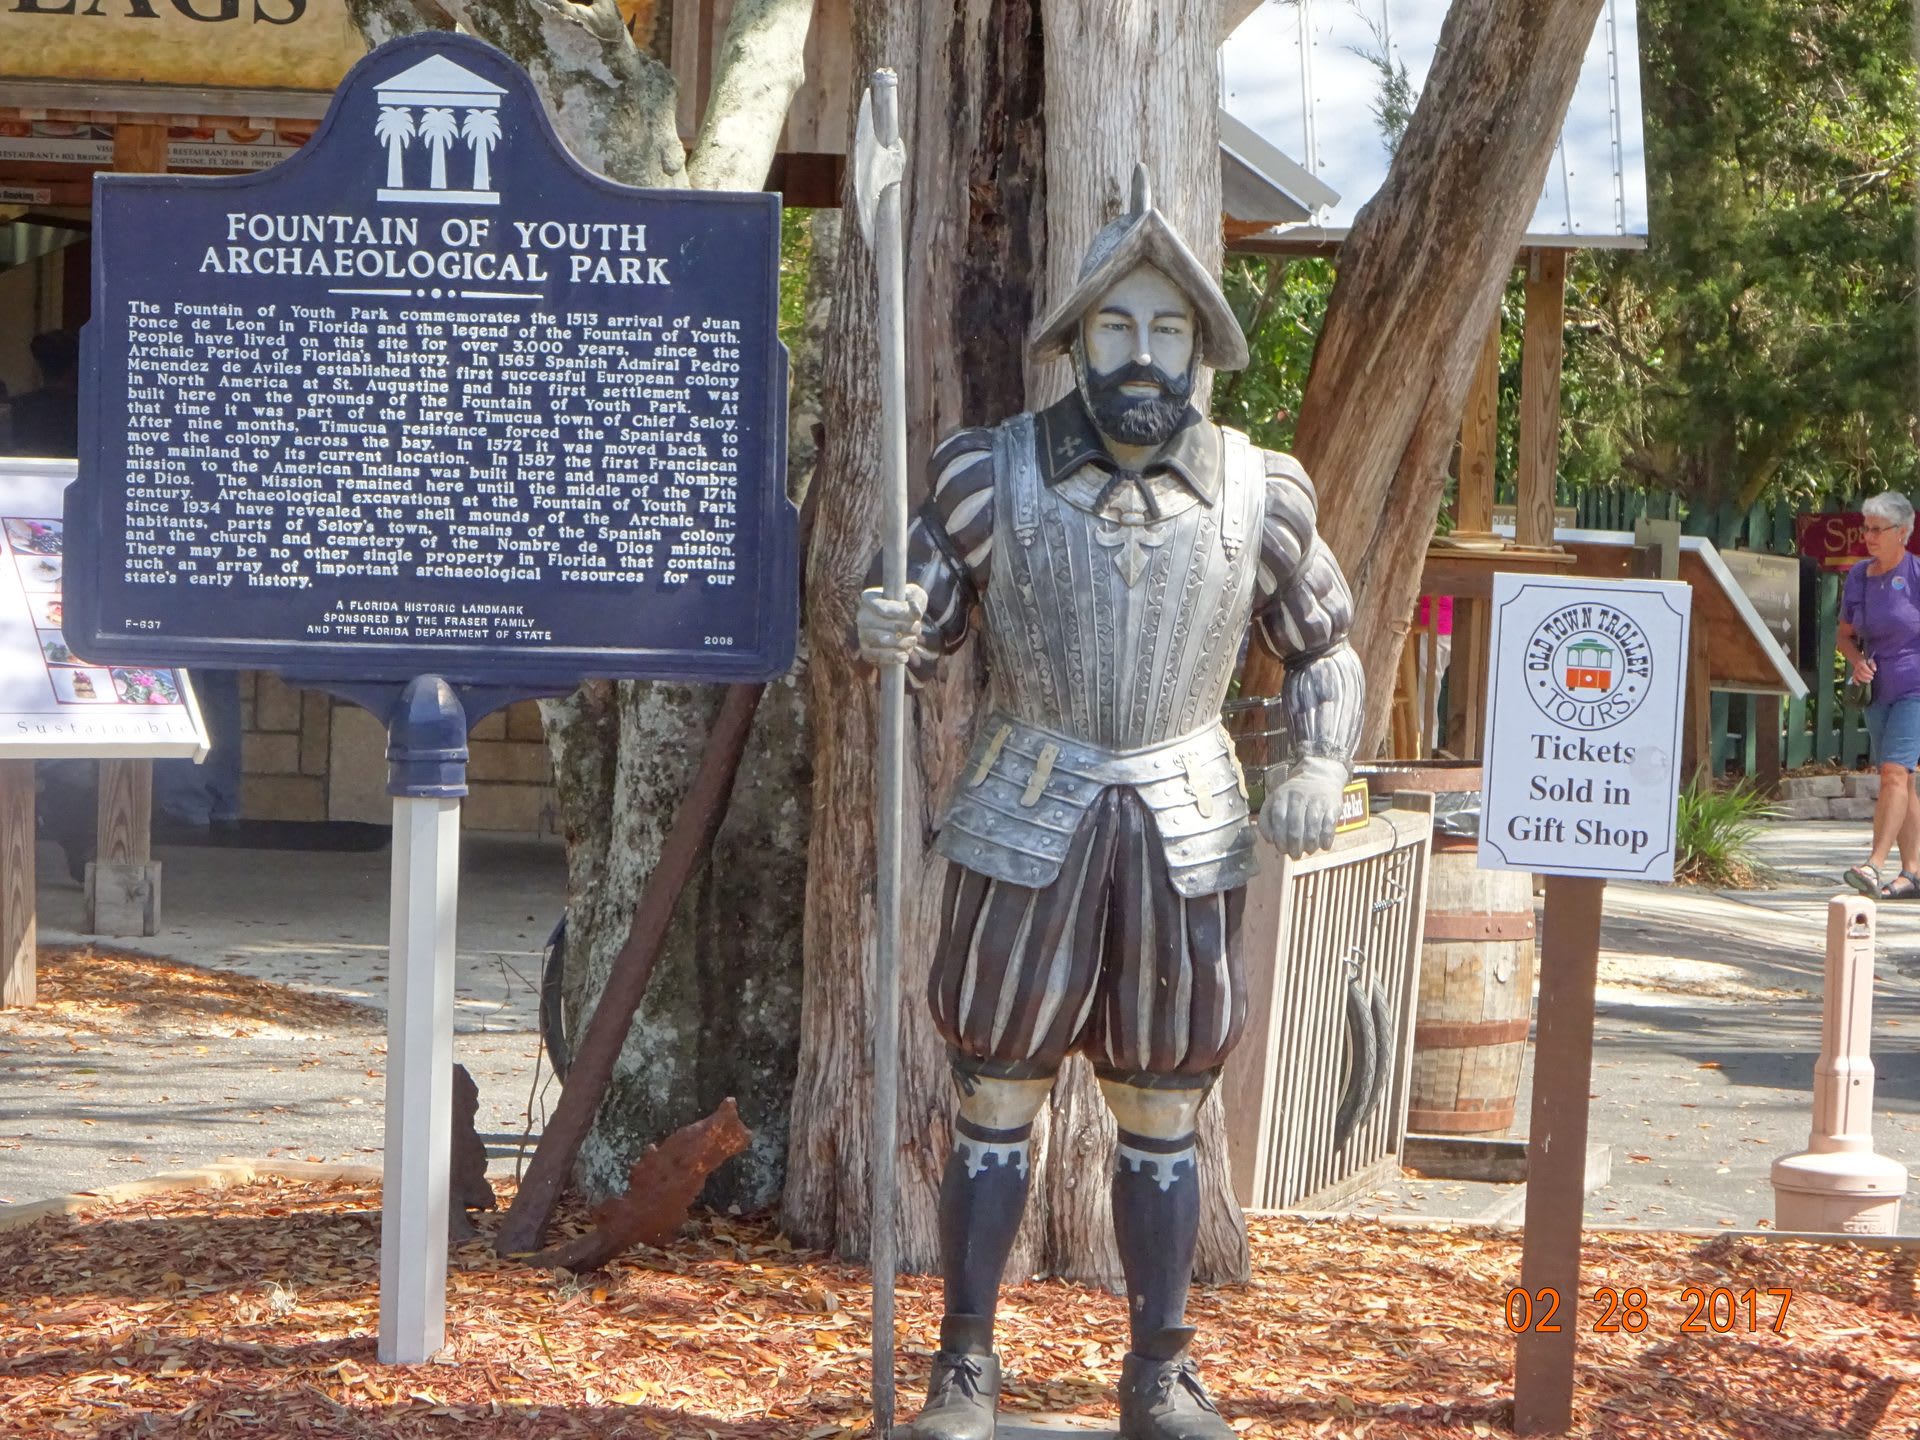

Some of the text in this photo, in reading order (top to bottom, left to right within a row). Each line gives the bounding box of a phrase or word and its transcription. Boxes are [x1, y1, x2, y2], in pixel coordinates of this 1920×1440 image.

[173, 148, 228, 157] RESTAURANT
[227, 212, 647, 252] FOUNTAIN OF YOUTH
[198, 246, 671, 286] ARCHAEOLOGICAL PARK
[126, 315, 740, 344] Ponce de Leon in Florida and the legend of the Fountain of Youth.
[128, 300, 740, 330] The Fountain of Youth Park commemorates the 1513 arrival of Juan
[128, 343, 740, 373] Archaic Period of Florida's history. In 1565 Spanish Admiral Pedro
[128, 372, 740, 402] in North America at St. Augustine and his first settlement was
[127, 414, 738, 445] After nine months, Timucua resistance forced the Spaniards to
[127, 443, 737, 473] the mainland to its current location. In 1587 the first Franciscan
[126, 486, 736, 514] century. Archaeological excavations at the Fountain of Youth Park
[126, 514, 736, 545] habitants, parts of Seloy's town, remains of the Spanish colony
[125, 542, 736, 571] There may be no other single property in Florida that contains
[124, 570, 313, 589] state's early history.
[323, 612, 535, 628] SPONSORED BY THE FRASER FAMILY
[336, 600, 524, 615] A FLORIDA HISTORIC LANDMARK
[125, 619, 161, 630] F-637
[306, 624, 552, 641] AND THE FLORIDA DEPARTMENT OF STATE
[704, 636, 733, 646] 2008
[1528, 606, 1649, 678] OLD TOWN TROLLEY
[1544, 688, 1633, 727] TOURS
[16, 719, 189, 736] Sustainable
[1531, 733, 1636, 764] Tickets
[1529, 775, 1631, 806] Sold in
[1507, 815, 1649, 854] Gift Shop
